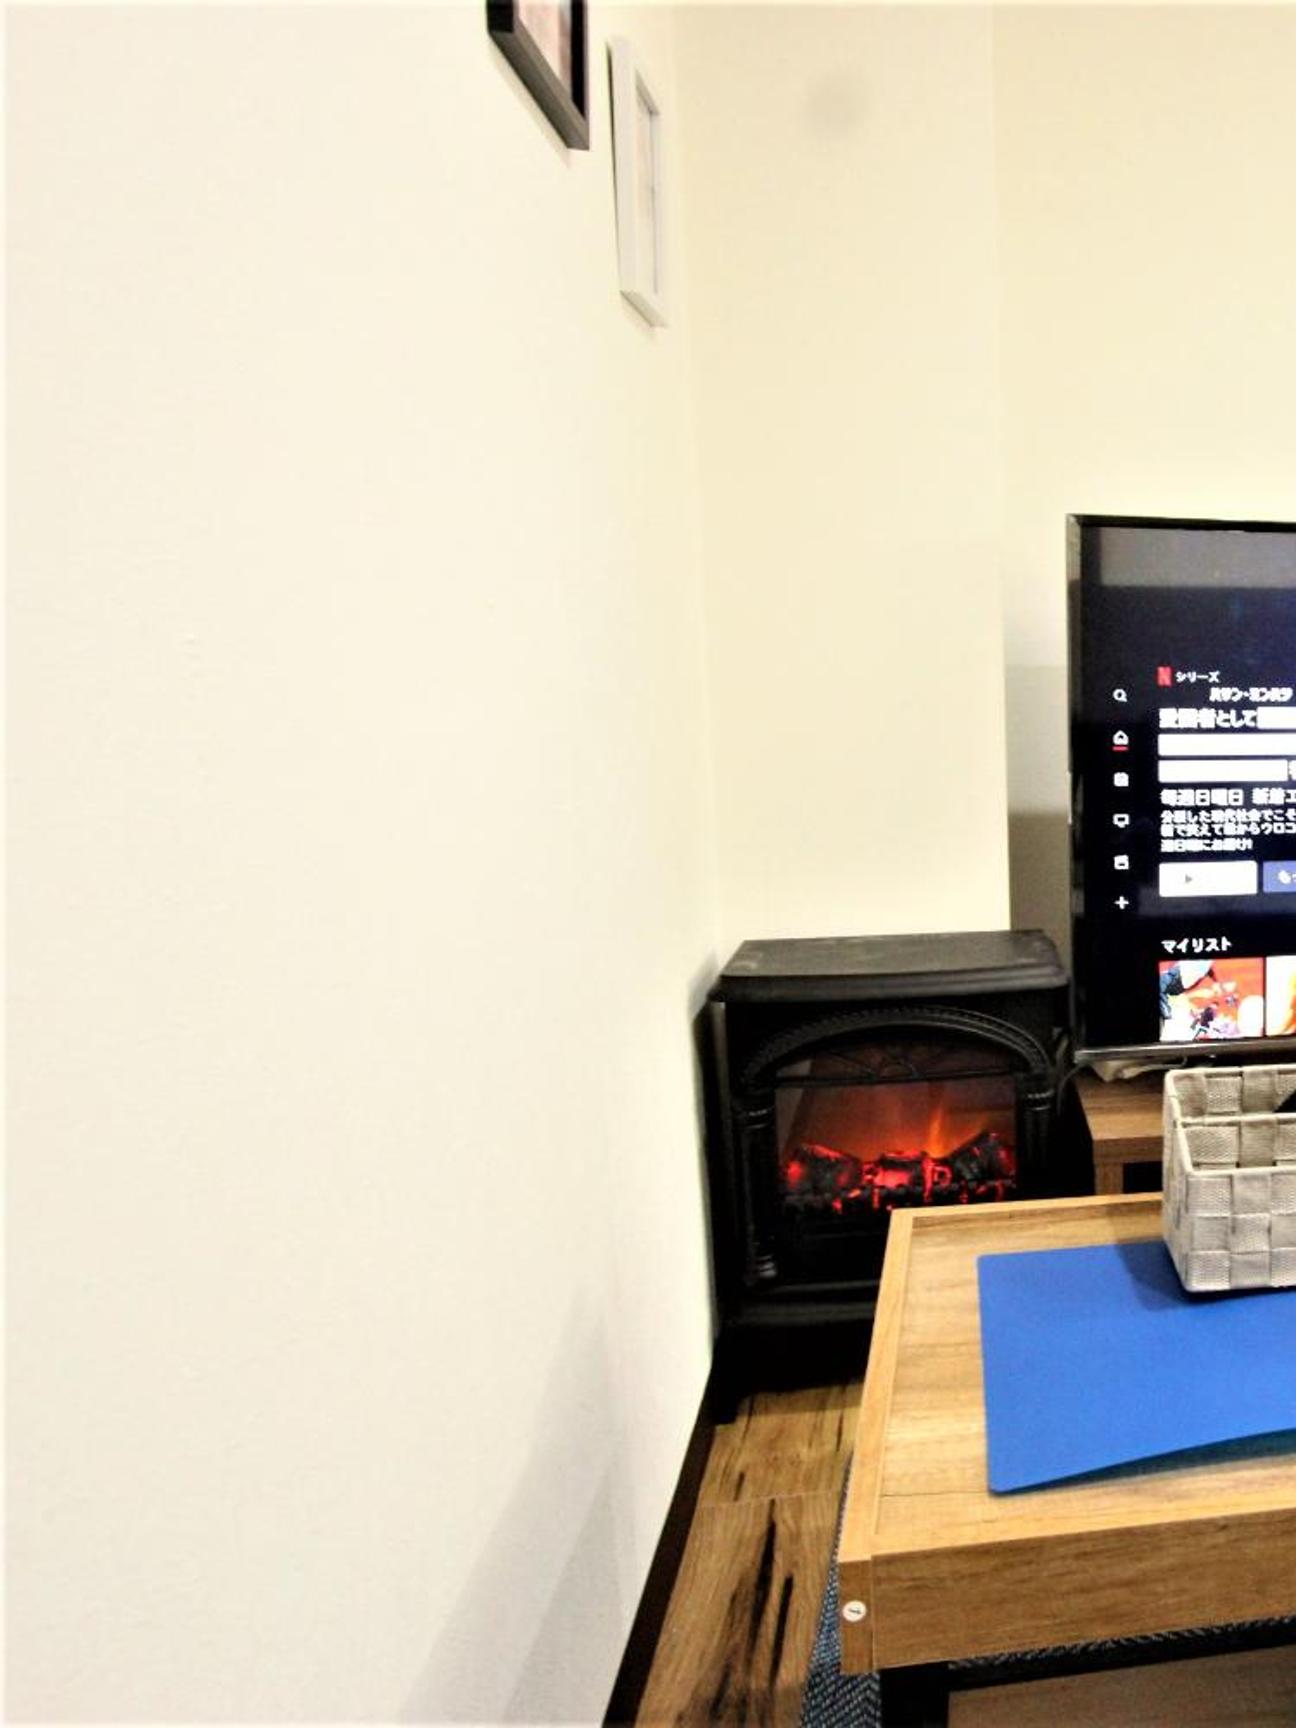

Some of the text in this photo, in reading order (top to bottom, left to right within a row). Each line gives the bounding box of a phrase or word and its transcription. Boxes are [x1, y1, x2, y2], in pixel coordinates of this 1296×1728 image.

[1175, 670, 1221, 683] シリーズ
[1161, 936, 1232, 954] マイリスト
